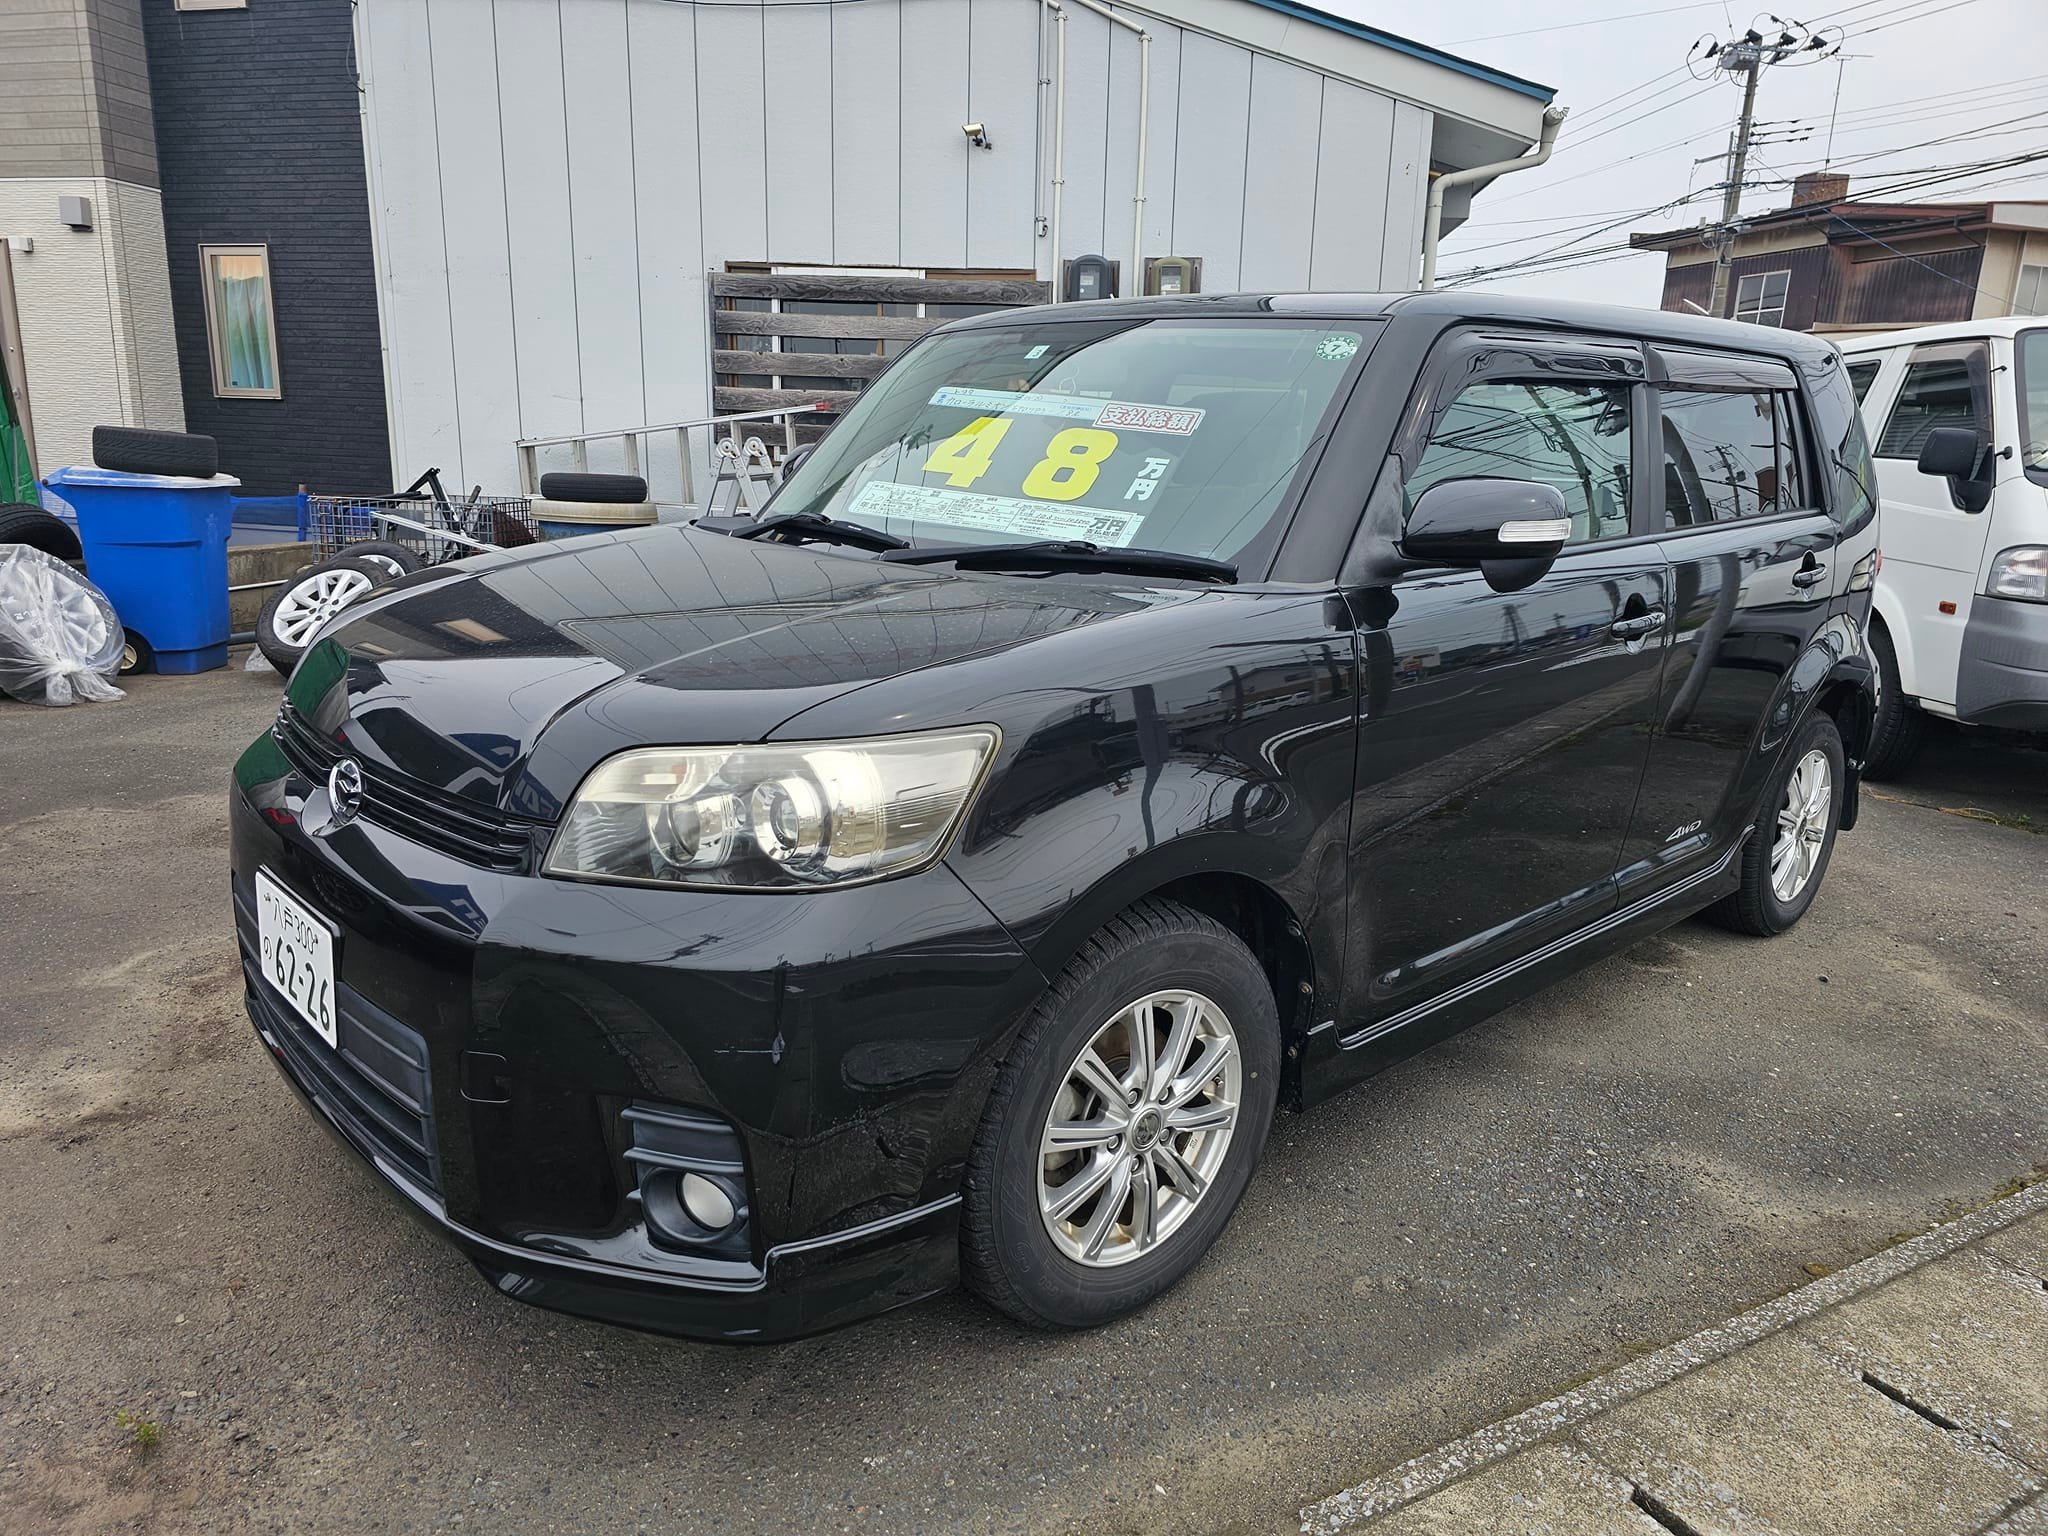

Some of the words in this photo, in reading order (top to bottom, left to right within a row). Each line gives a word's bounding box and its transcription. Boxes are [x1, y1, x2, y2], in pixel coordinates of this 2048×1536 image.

[1102, 407, 1196, 431] 支払総額
[1089, 517, 1127, 532] 万円
[263, 936, 272, 960] の
[276, 935, 330, 1032] 62-26
